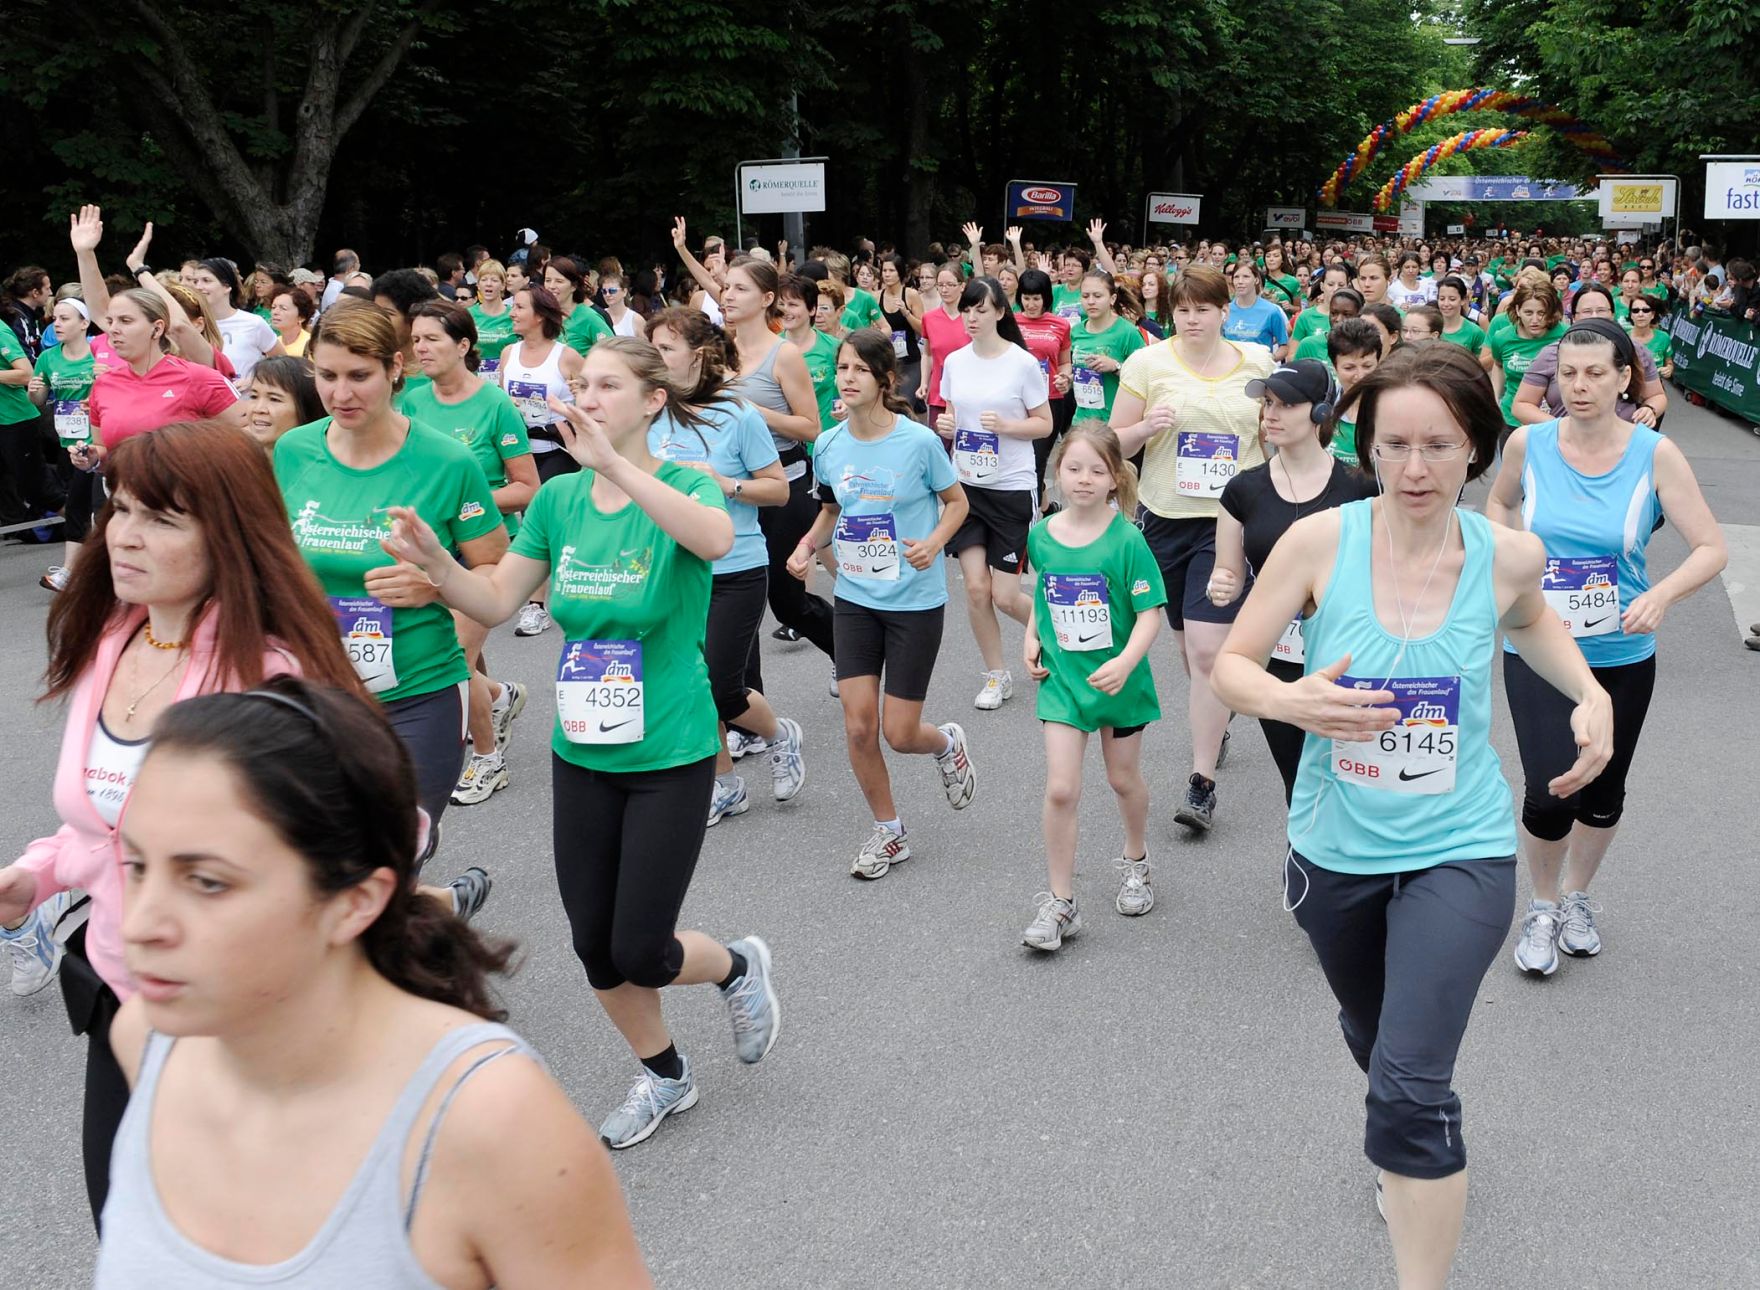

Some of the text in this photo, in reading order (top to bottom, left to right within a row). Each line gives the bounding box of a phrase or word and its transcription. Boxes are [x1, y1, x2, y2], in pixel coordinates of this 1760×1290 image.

[763, 180, 818, 190] RÖMERQUELLE
[1031, 191, 1057, 200] Barilla
[1154, 203, 1193, 218] Kellogg's
[970, 455, 998, 467] 5313
[1201, 463, 1236, 477] 1430
[857, 544, 897, 558] 3024
[1587, 573, 1607, 585] dm
[1079, 590, 1098, 600] dm
[1569, 590, 1617, 610] 5484
[1062, 608, 1108, 623] 11193
[355, 618, 379, 632] dm
[607, 660, 630, 675] dm
[586, 688, 640, 708] 4352
[1412, 702, 1444, 719] dm
[1380, 731, 1454, 755] 6145
